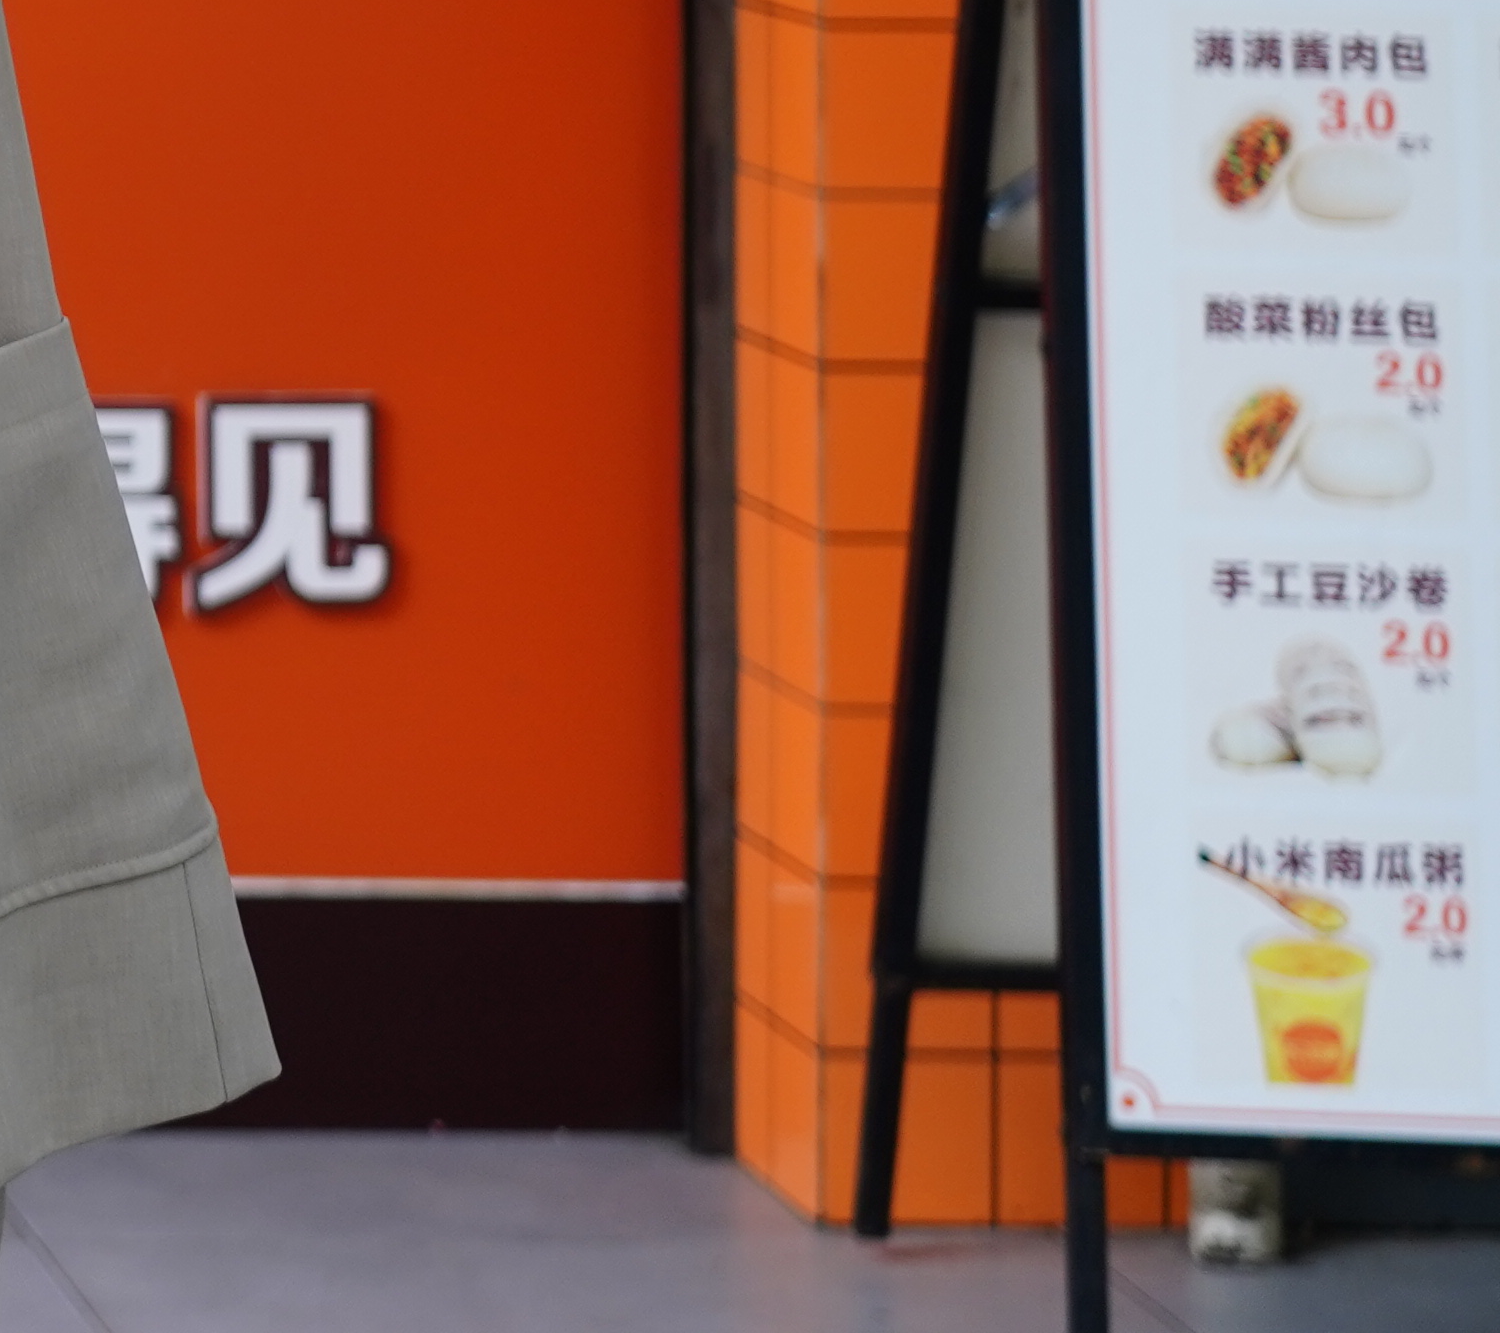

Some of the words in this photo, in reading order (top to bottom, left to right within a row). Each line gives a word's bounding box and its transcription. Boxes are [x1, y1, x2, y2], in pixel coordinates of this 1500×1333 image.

[1318, 87, 1396, 139] 3.0
[1373, 349, 1445, 396] 2.0
[1212, 559, 1449, 611] 手工豆沙卷
[1380, 618, 1452, 667] 2.0
[1401, 894, 1469, 940] 2.0
